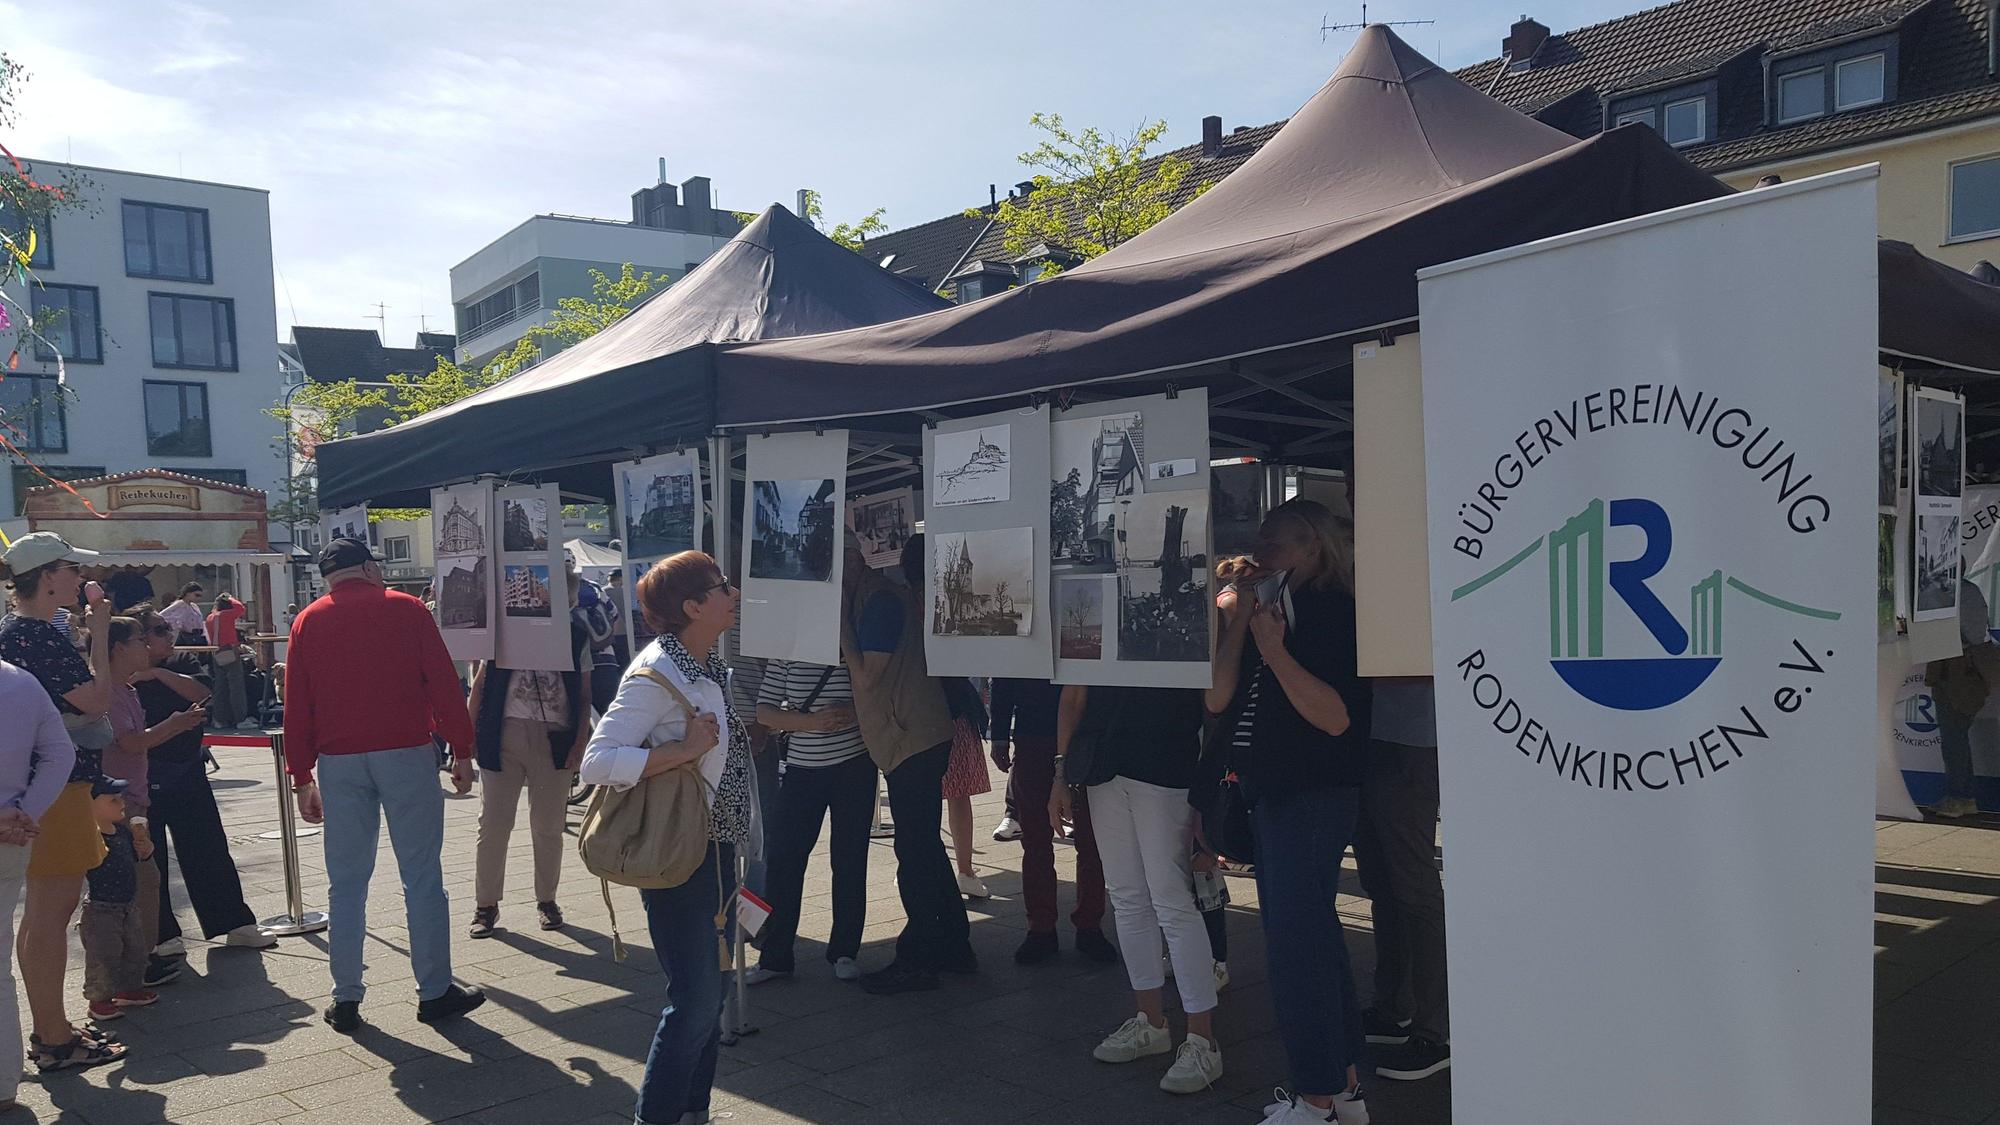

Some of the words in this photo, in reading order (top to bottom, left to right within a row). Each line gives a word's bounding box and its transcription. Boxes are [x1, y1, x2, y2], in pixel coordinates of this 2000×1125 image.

[119, 489, 188, 501] Reibekuchen
[1453, 384, 1831, 560] BÜRGERVEREINIGUNG
[1457, 649, 1769, 791] RODENKIRCHEN
[1773, 638, 1834, 714] e.V.
